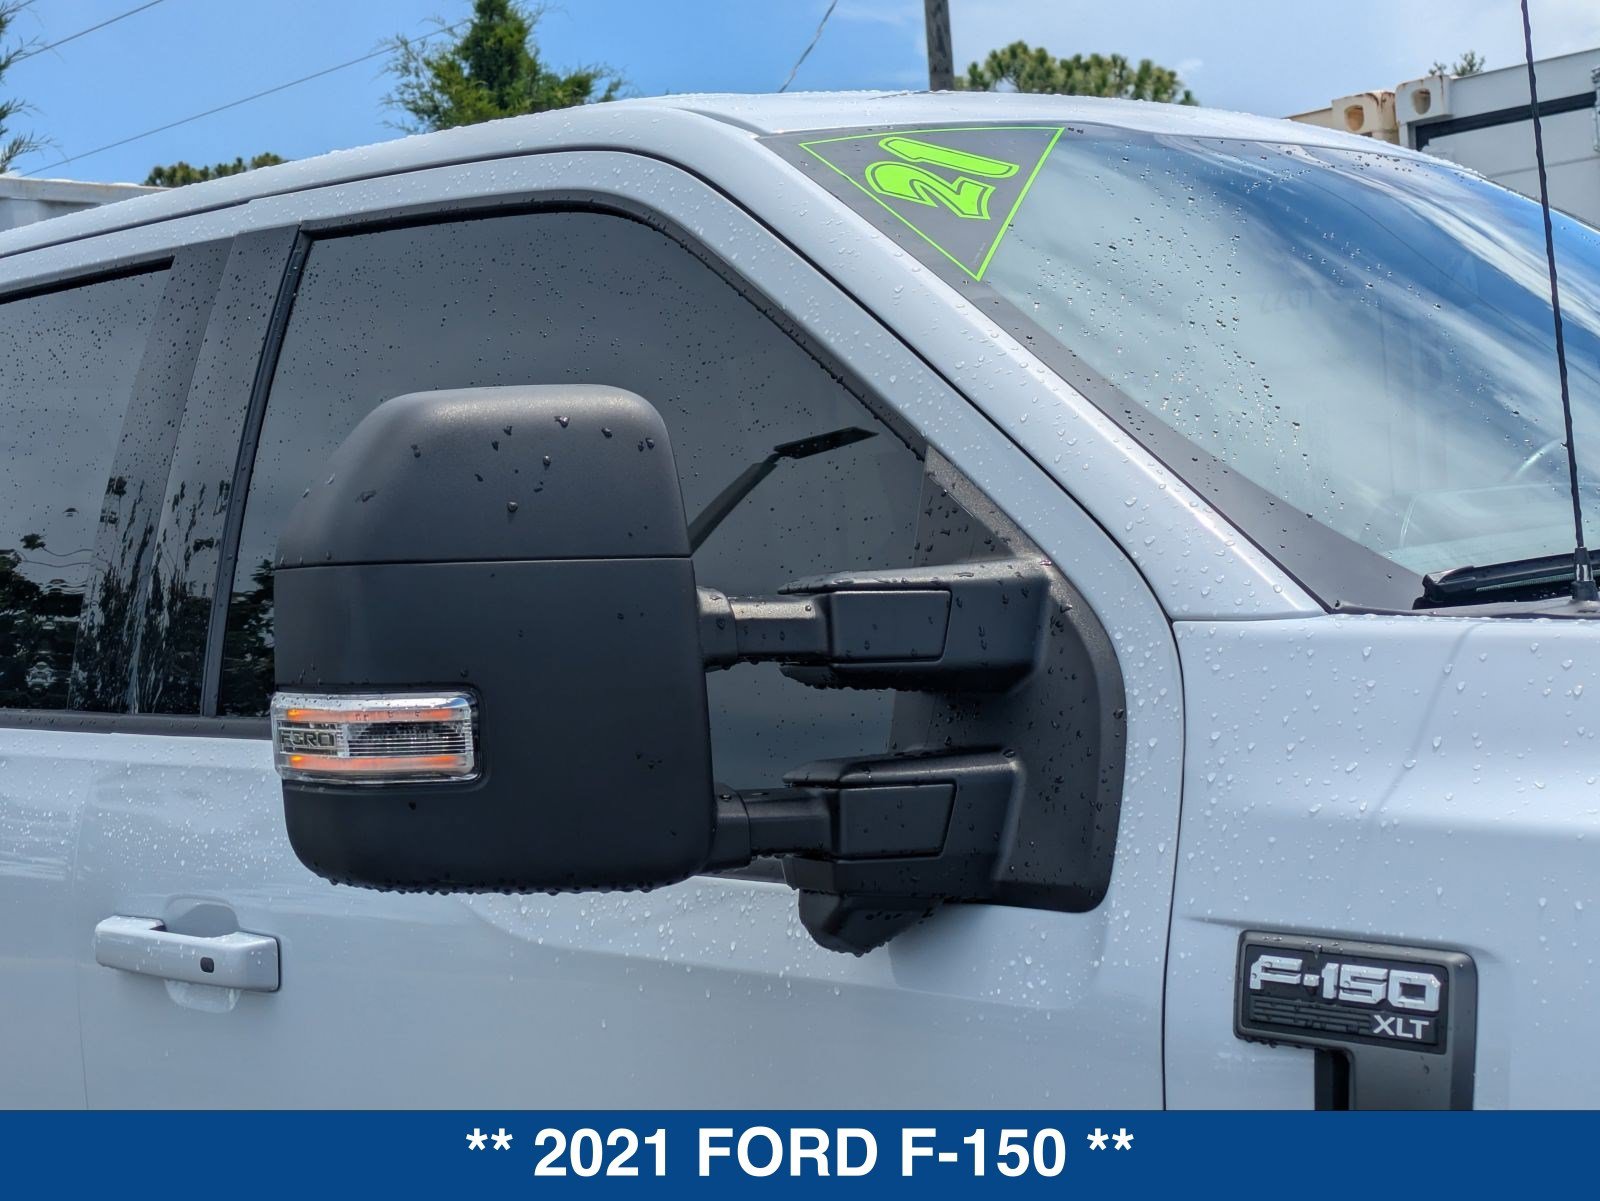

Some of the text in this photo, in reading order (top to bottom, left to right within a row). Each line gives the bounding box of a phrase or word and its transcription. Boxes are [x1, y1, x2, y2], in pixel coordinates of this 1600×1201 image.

[864, 136, 1020, 220] 21
[1250, 954, 1441, 1012] F-150
[1373, 1014, 1430, 1040] XLT
